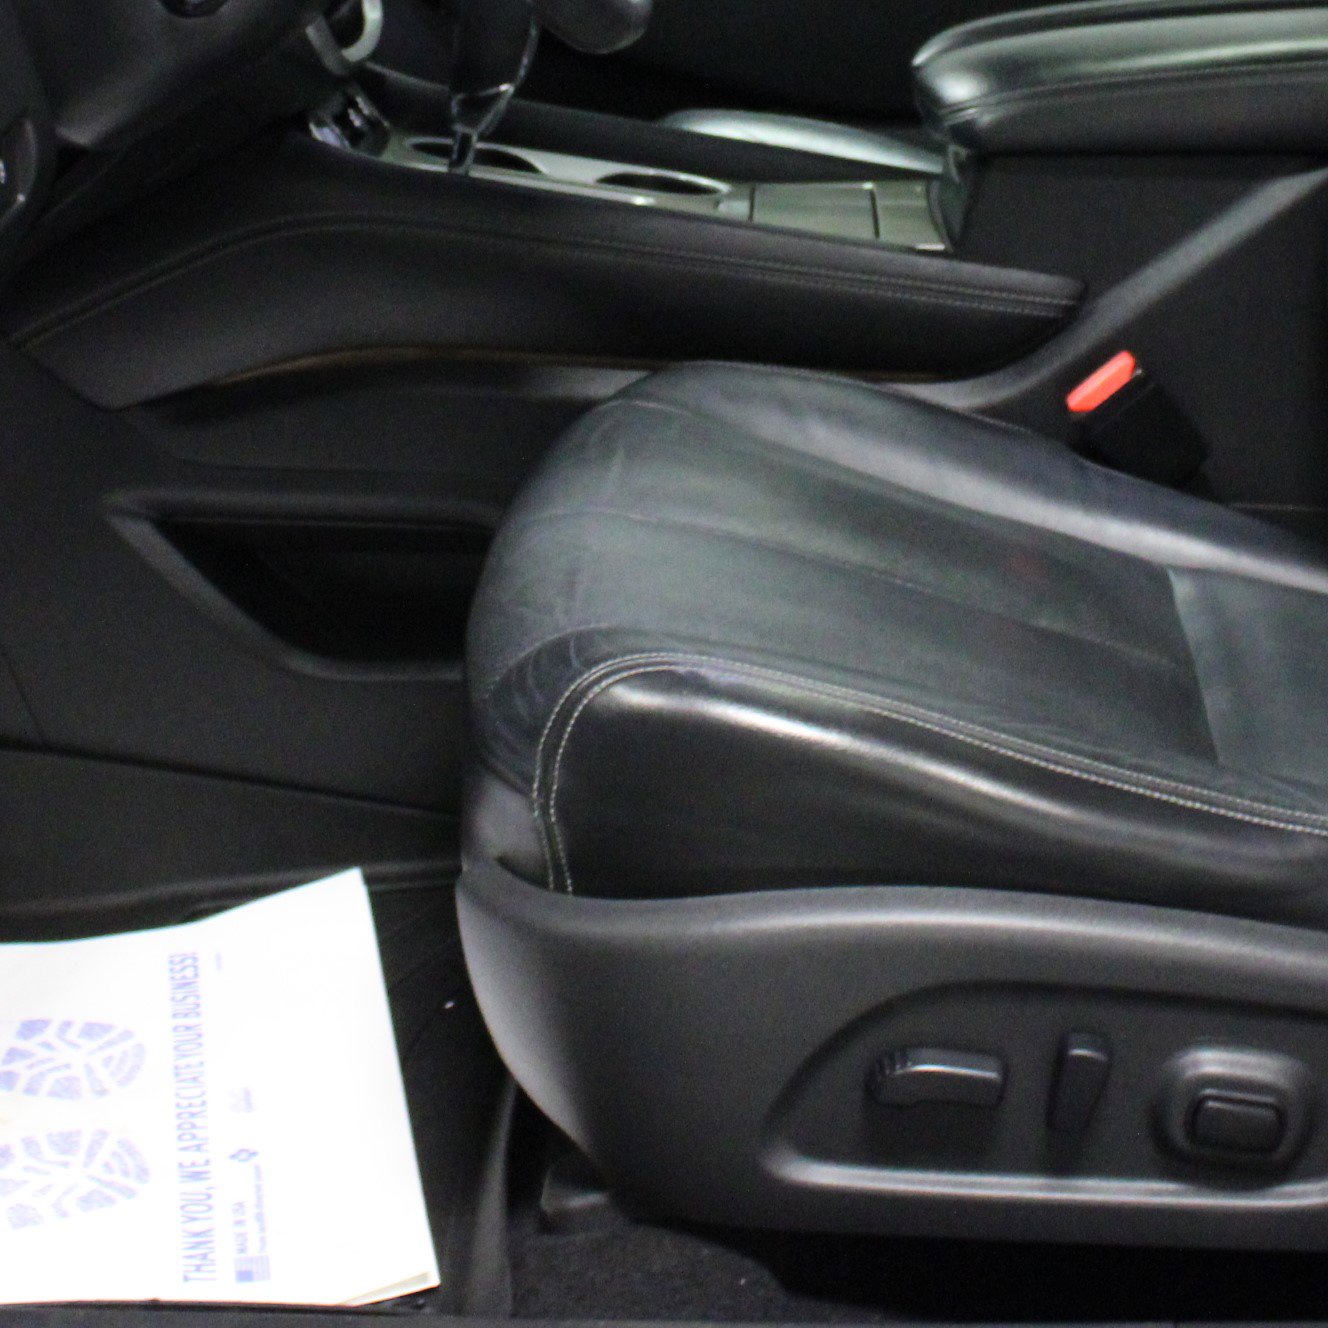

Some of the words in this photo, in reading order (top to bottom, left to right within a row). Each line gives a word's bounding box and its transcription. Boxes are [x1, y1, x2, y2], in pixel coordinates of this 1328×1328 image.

[169, 951, 201, 1019] BUSINESS!
[172, 1023, 204, 1061] YOUR
[174, 1061, 210, 1153] APPRECIATE
[177, 1158, 212, 1184] WE
[179, 1186, 215, 1224] YOU,
[182, 1228, 217, 1283] THANK
